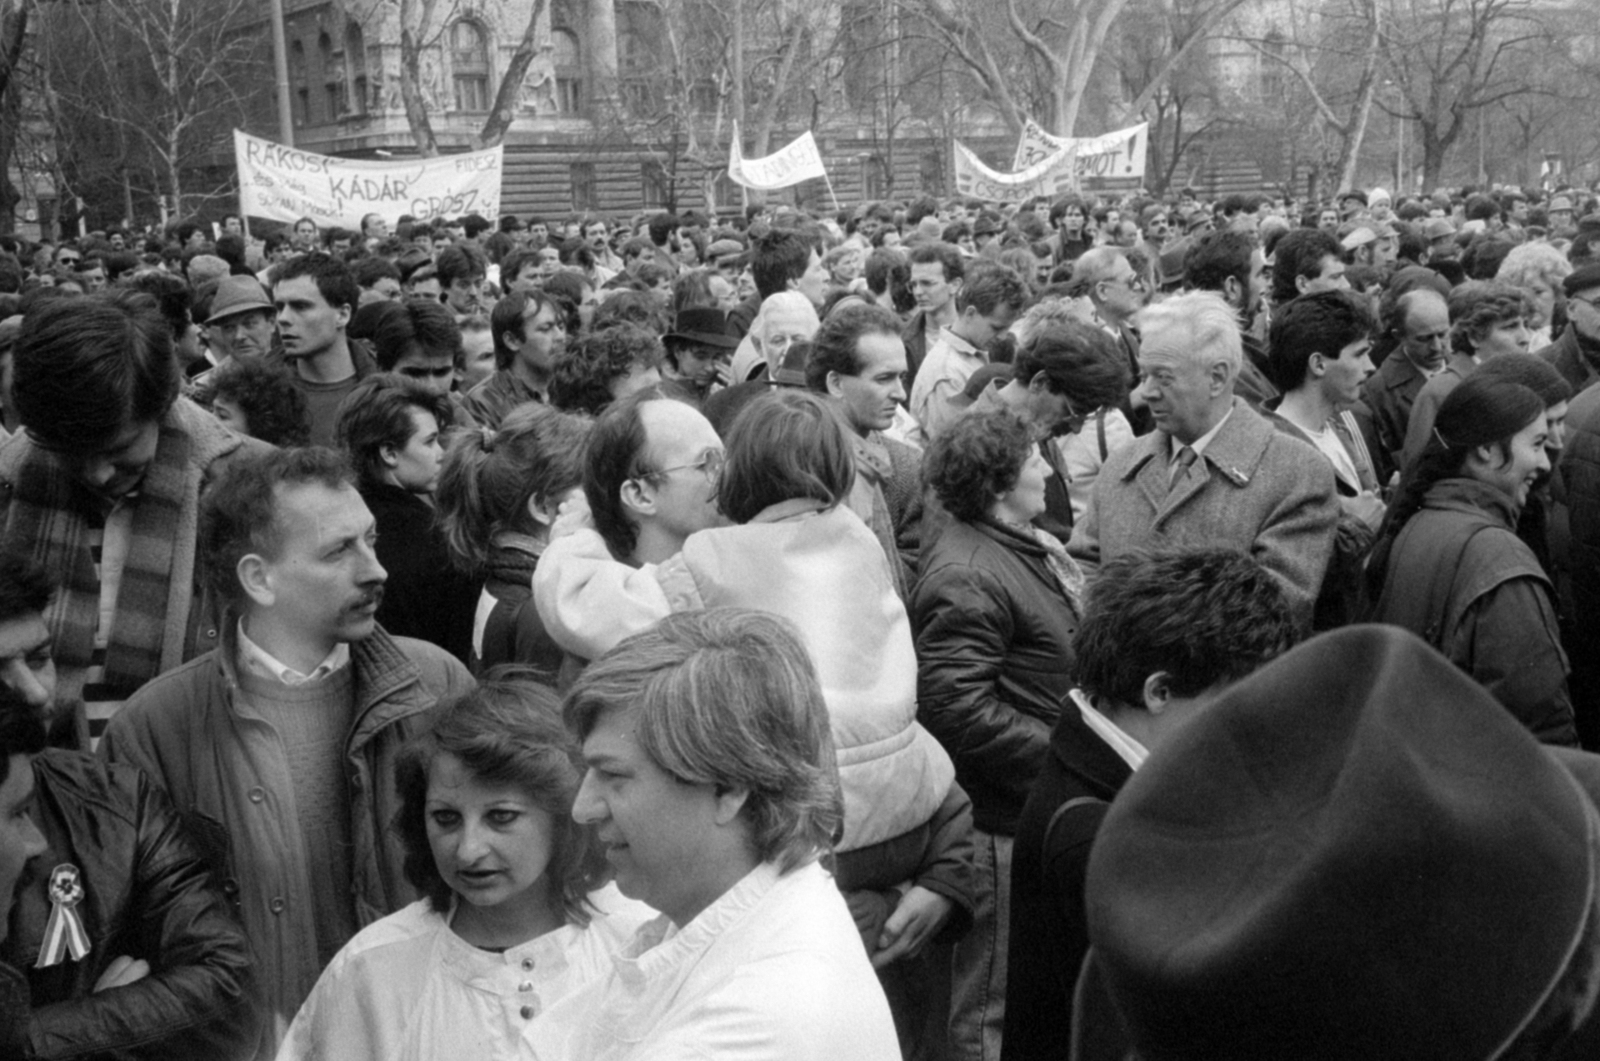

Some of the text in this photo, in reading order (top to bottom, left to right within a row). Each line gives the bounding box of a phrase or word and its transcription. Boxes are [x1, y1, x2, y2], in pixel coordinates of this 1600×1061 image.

[455, 153, 498, 173] FIDESZ
[328, 174, 409, 202] KÁDÁR
[411, 187, 480, 221] GRÓSZ
